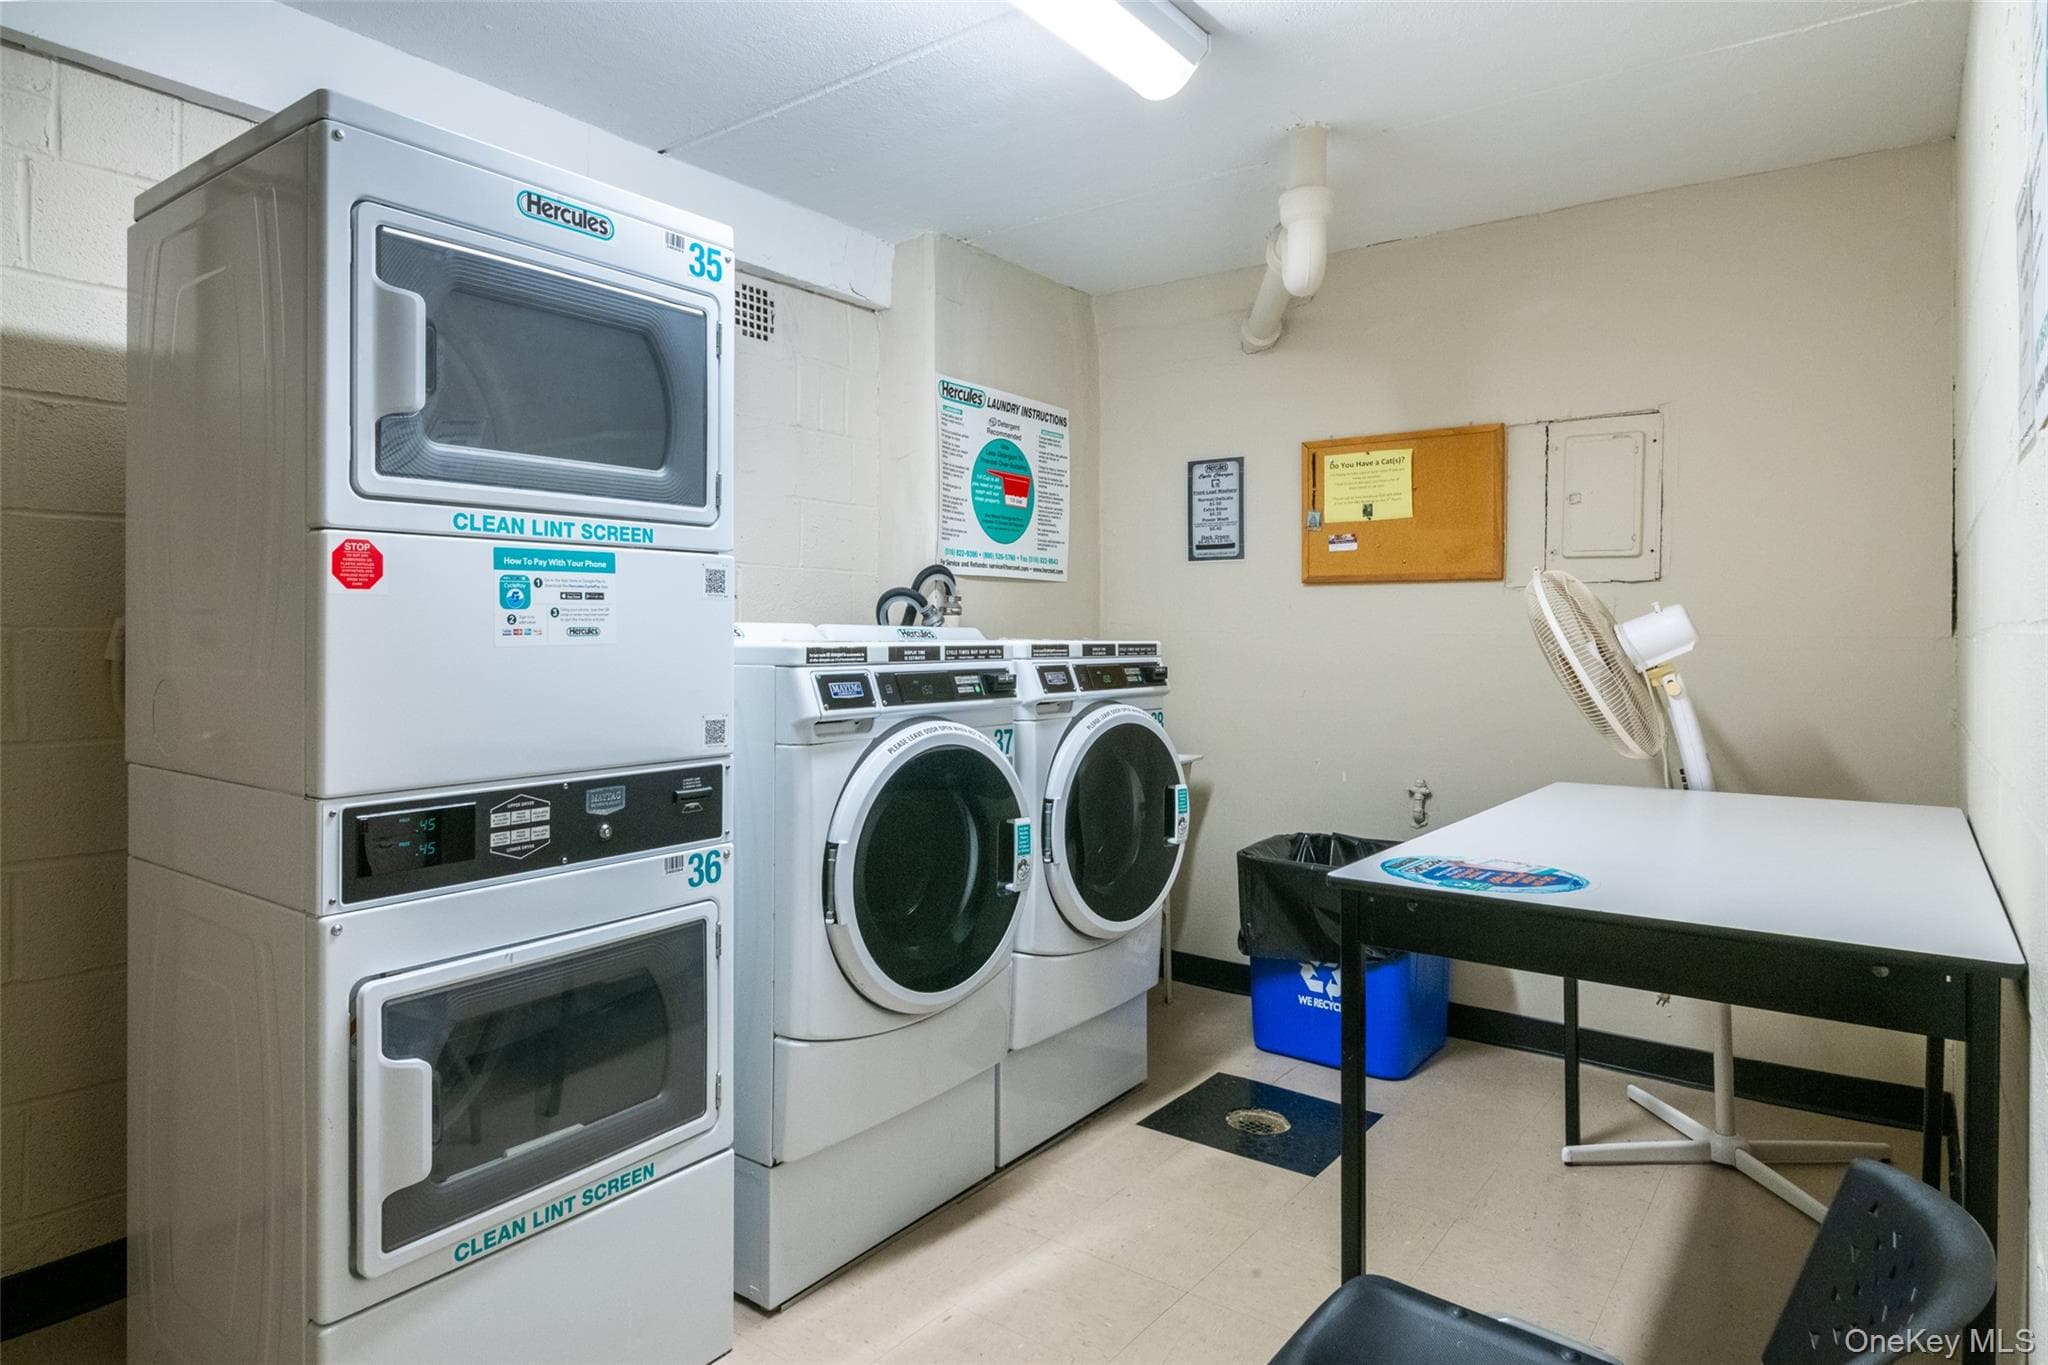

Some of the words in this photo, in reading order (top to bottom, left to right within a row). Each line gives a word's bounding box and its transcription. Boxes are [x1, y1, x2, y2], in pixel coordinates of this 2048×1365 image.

[526, 191, 609, 235] Hercules
[688, 242, 722, 282] 35
[942, 381, 982, 405] Hercules
[987, 397, 1020, 415] LAUNDRY
[1021, 406, 1068, 427] INSTRUCTIONS
[997, 419, 1020, 431] Detergent
[986, 427, 1022, 441] Recommended
[1356, 459, 1373, 467] Have
[1381, 456, 1405, 465] Cat(s)?
[453, 512, 525, 535] CLEAN
[532, 520, 575, 539] LINT
[581, 524, 654, 544] SCREEN
[344, 542, 370, 551] STOP
[503, 556, 522, 566] How
[522, 557, 533, 566] To
[534, 558, 547, 568] Pay
[548, 558, 566, 567] With
[567, 559, 584, 568] Your
[584, 560, 607, 569] Phone
[899, 629, 935, 639] Hercules
[831, 682, 861, 693] MAYTAG
[887, 738, 908, 755] PLEASE
[907, 730, 924, 742] LEAVE
[923, 725, 939, 734] DOOR
[994, 729, 1013, 754] 37
[591, 791, 622, 803] MAYTAG
[420, 818, 436, 831] 45
[419, 841, 436, 855] 45
[688, 849, 721, 887] 36
[1297, 994, 1313, 1007] WE
[454, 1217, 525, 1262] CLEAN
[533, 1196, 576, 1228] LINT
[582, 1162, 655, 1206] SCREEN
